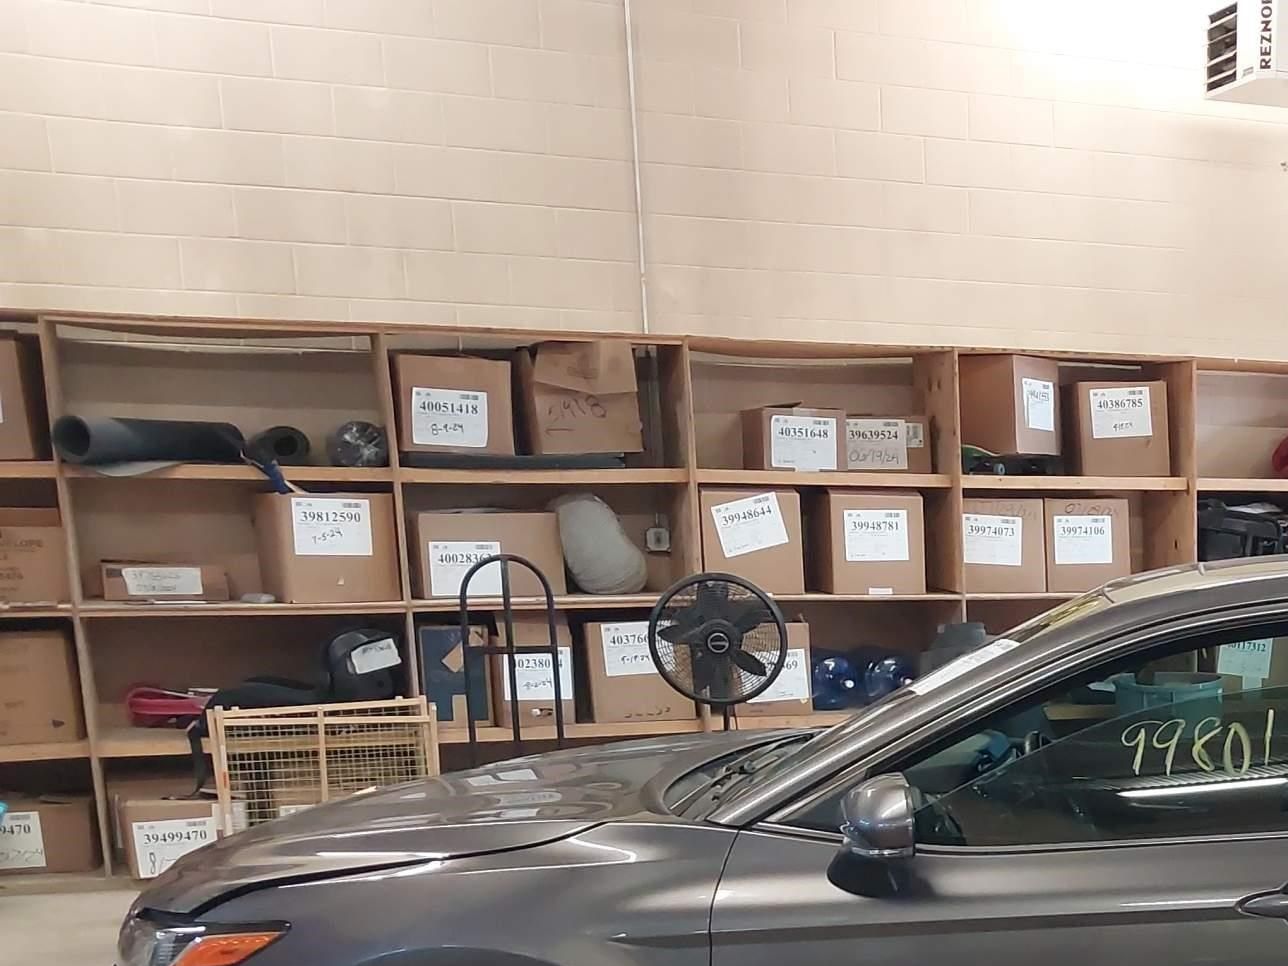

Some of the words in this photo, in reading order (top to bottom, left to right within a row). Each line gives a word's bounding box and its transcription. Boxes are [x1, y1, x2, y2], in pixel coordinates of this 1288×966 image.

[419, 401, 479, 415] 40051418
[1097, 398, 1143, 409] 40386785
[778, 427, 829, 439] 40351648
[849, 429, 899, 440] 39639524
[300, 511, 361, 523] 39812590
[722, 505, 773, 526] 39948644
[851, 521, 900, 531] 39948781
[967, 524, 1015, 537] 39974073
[1060, 526, 1105, 537] 39974106
[1121, 709, 1274, 777] 99801
[143, 830, 208, 845] 39499470
